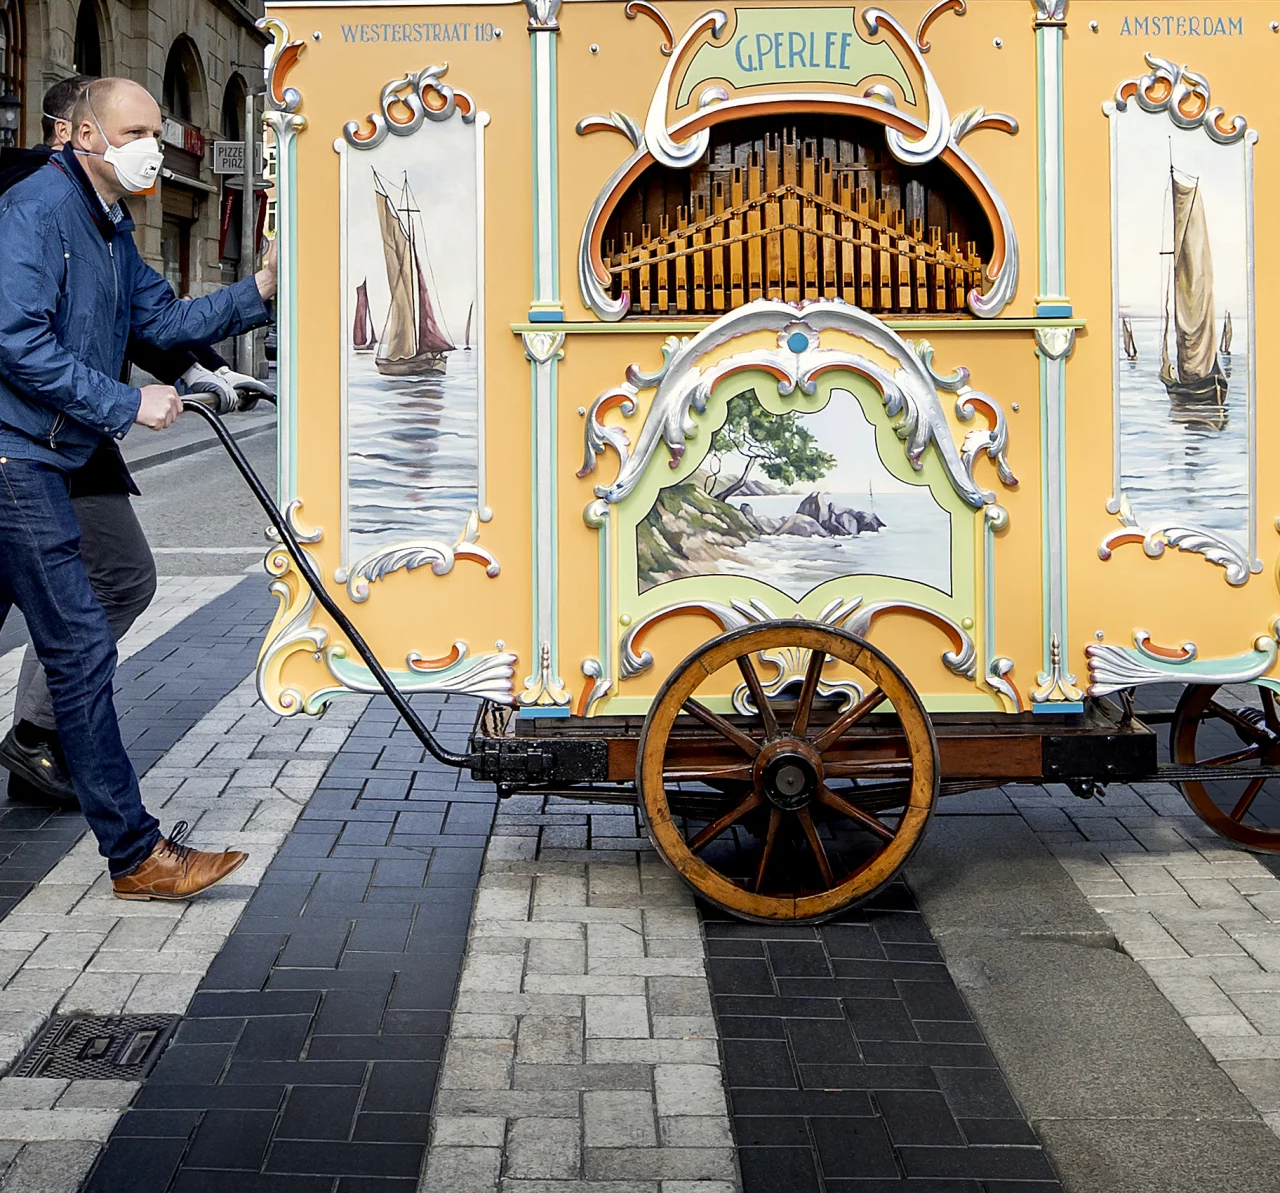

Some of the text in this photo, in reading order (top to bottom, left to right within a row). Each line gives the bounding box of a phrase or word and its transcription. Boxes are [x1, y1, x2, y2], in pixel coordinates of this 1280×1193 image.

[341, 22, 494, 43] WESTERSTRAAT 119
[1120, 15, 1243, 36] AMSTERDAM
[218, 147, 258, 157] PIZZE
[222, 158, 244, 168] PIAZ
